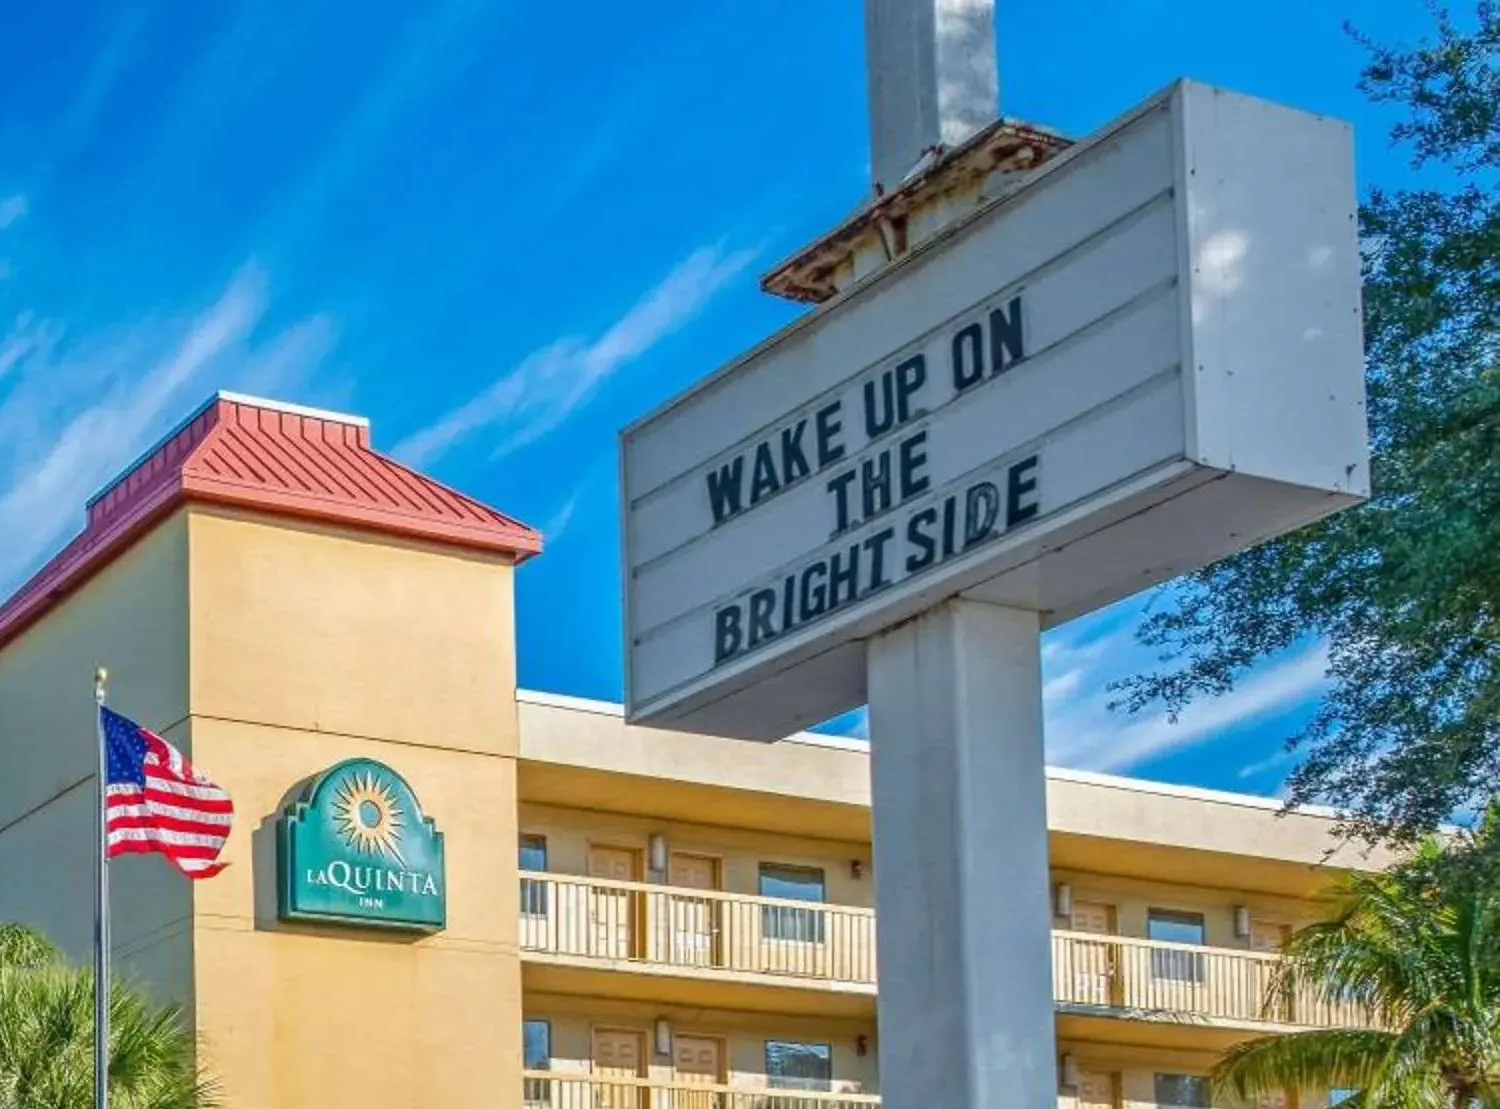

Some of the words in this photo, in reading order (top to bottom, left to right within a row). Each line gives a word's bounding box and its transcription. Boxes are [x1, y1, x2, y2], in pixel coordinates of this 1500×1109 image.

[706, 401, 846, 527] WAKE
[863, 353, 927, 439] UP
[951, 297, 1024, 392] ON
[827, 430, 931, 535] THE
[359, 897, 384, 909] INN
